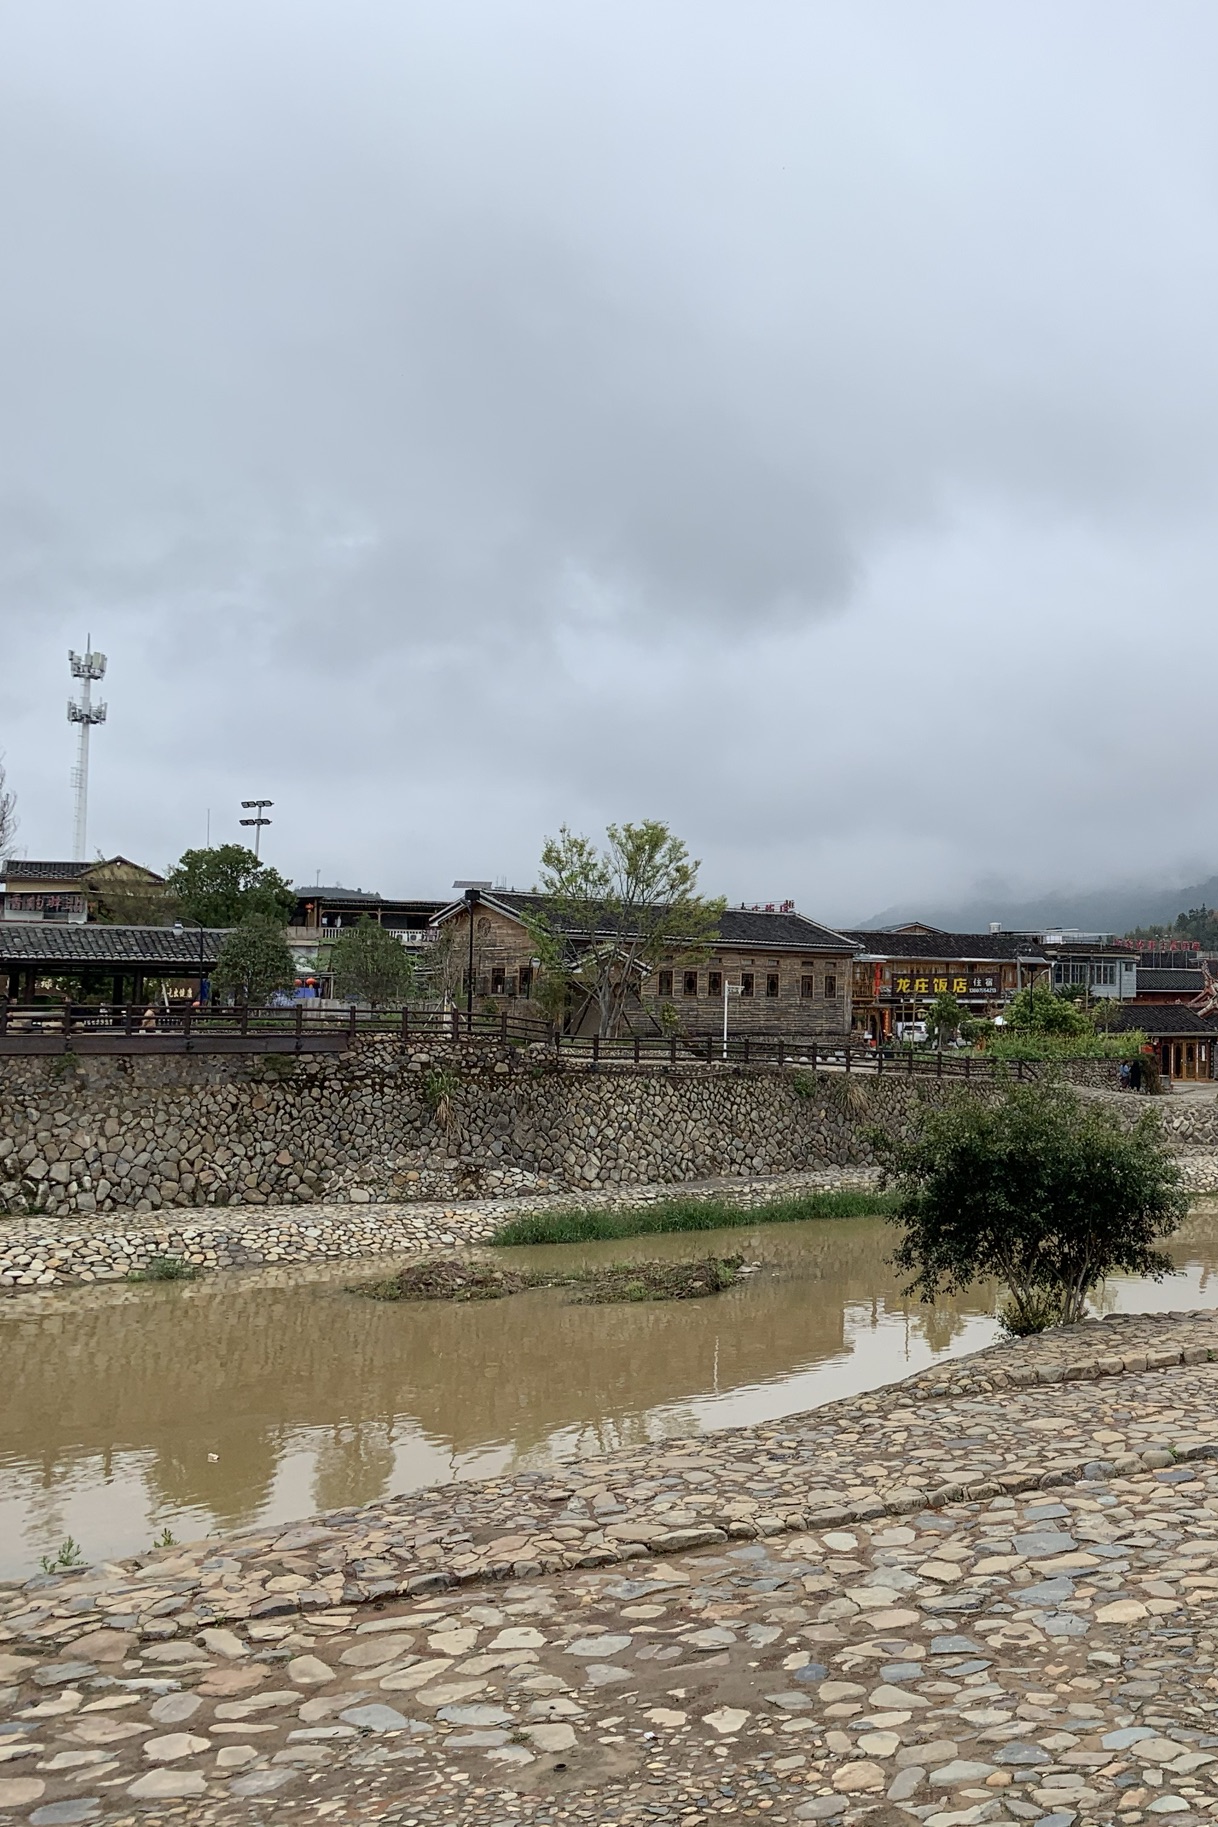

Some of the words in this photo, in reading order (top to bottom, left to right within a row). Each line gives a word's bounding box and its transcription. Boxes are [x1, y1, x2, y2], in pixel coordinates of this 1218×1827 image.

[896, 977, 967, 993] 龙庄饭店
[972, 977, 994, 987] 住宿
